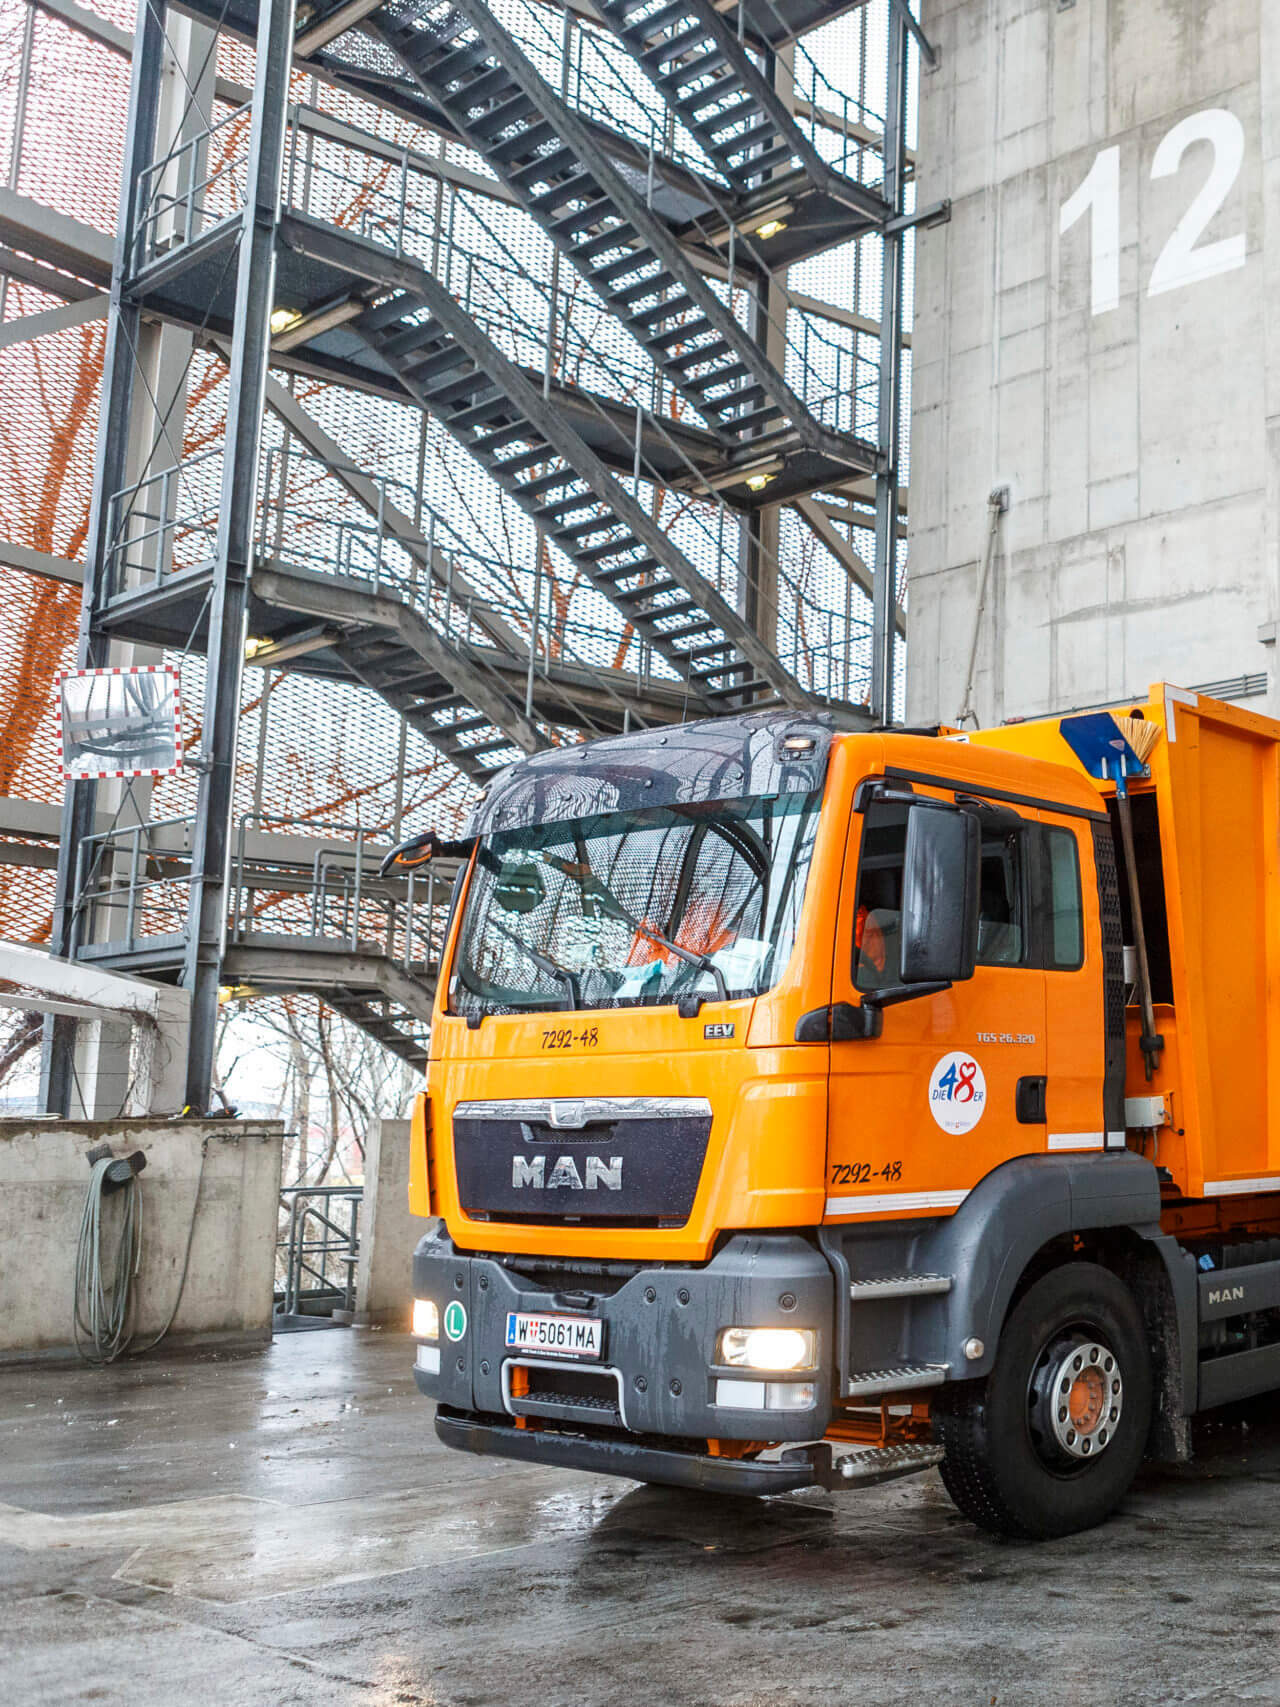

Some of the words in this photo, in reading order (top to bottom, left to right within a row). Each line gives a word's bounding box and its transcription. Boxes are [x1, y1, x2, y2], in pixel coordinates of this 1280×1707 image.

[1060, 109, 1247, 316] 12
[541, 1027, 600, 1049] 7292-48
[705, 1024, 735, 1038] EEV
[976, 1032, 998, 1044] TGS
[999, 1033, 1036, 1045] 26.320
[939, 1061, 977, 1103] 48
[932, 1089, 948, 1101] DIE
[973, 1091, 985, 1102] ER
[512, 1155, 624, 1191] MAN
[831, 1160, 903, 1185] 7292-48
[1208, 1286, 1245, 1304] MAN
[450, 1308, 461, 1335] L
